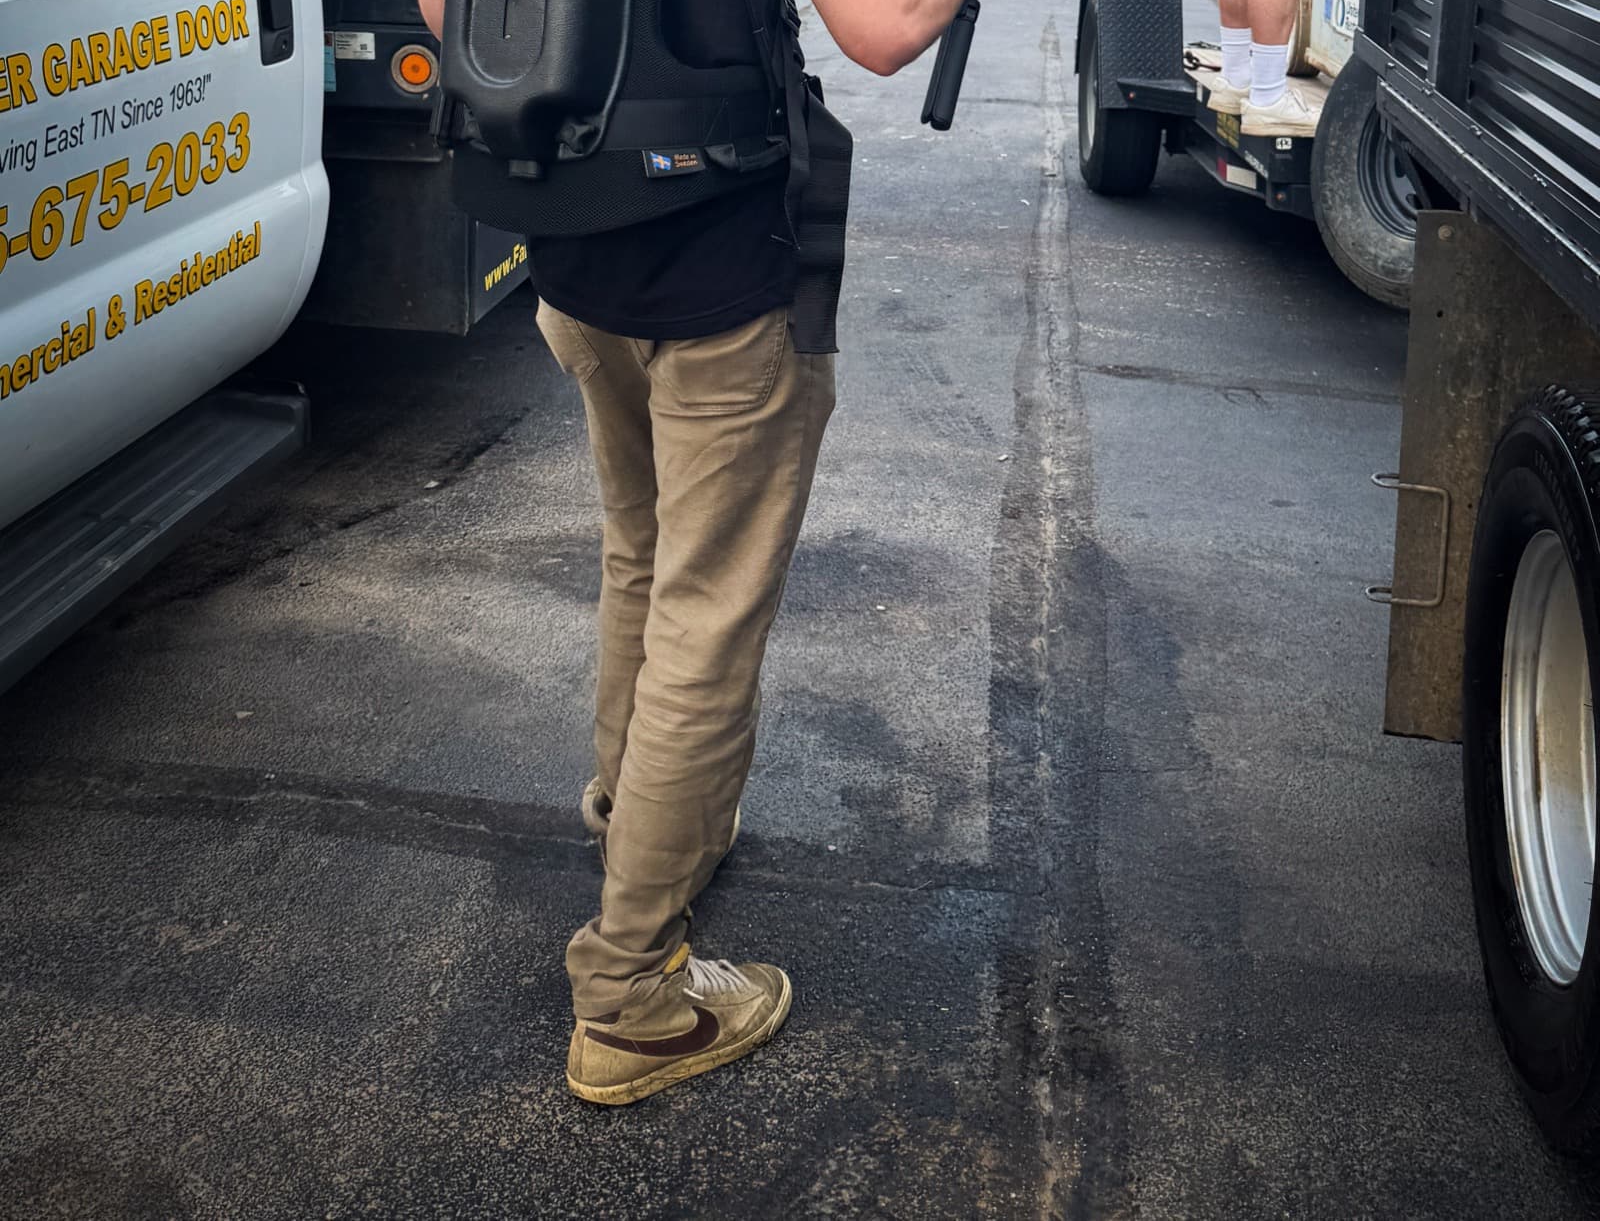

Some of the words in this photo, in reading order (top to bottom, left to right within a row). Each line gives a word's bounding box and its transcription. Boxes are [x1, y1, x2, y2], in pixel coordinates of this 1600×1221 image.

[42, 15, 172, 96] GARAGE
[44, 117, 85, 158] East
[91, 105, 116, 140] TN
[121, 98, 164, 130] Since
[105, 294, 127, 340] &
[134, 221, 262, 328] Residential
